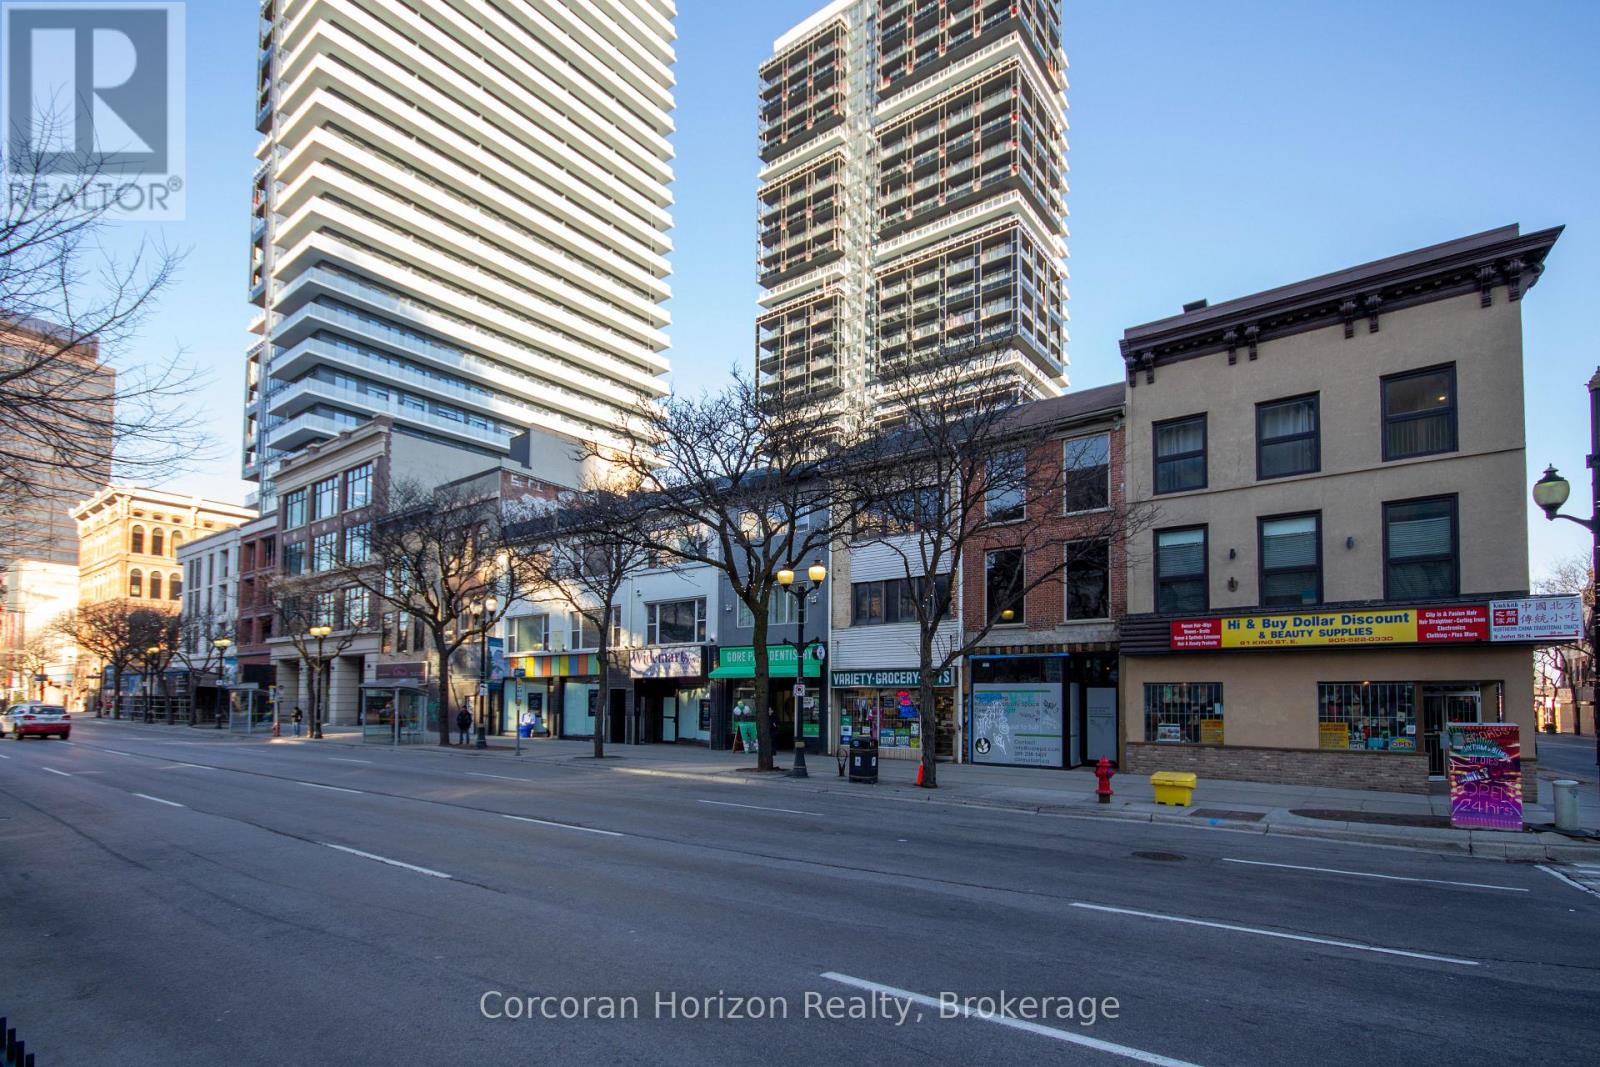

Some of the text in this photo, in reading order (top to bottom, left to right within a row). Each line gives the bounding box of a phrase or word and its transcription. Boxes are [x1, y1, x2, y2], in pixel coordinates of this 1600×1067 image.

[1521, 599, 1580, 612] 中國北方
[1228, 613, 1409, 630] Hi & Buy Dollar Discount
[1521, 612, 1579, 625] 傳統小吃
[1258, 627, 1373, 639] & BEAUTY SUPPLIES
[726, 651, 747, 662] GORE
[769, 649, 812, 662] DENTISRY
[834, 671, 919, 685] VARIETY GROCERY
